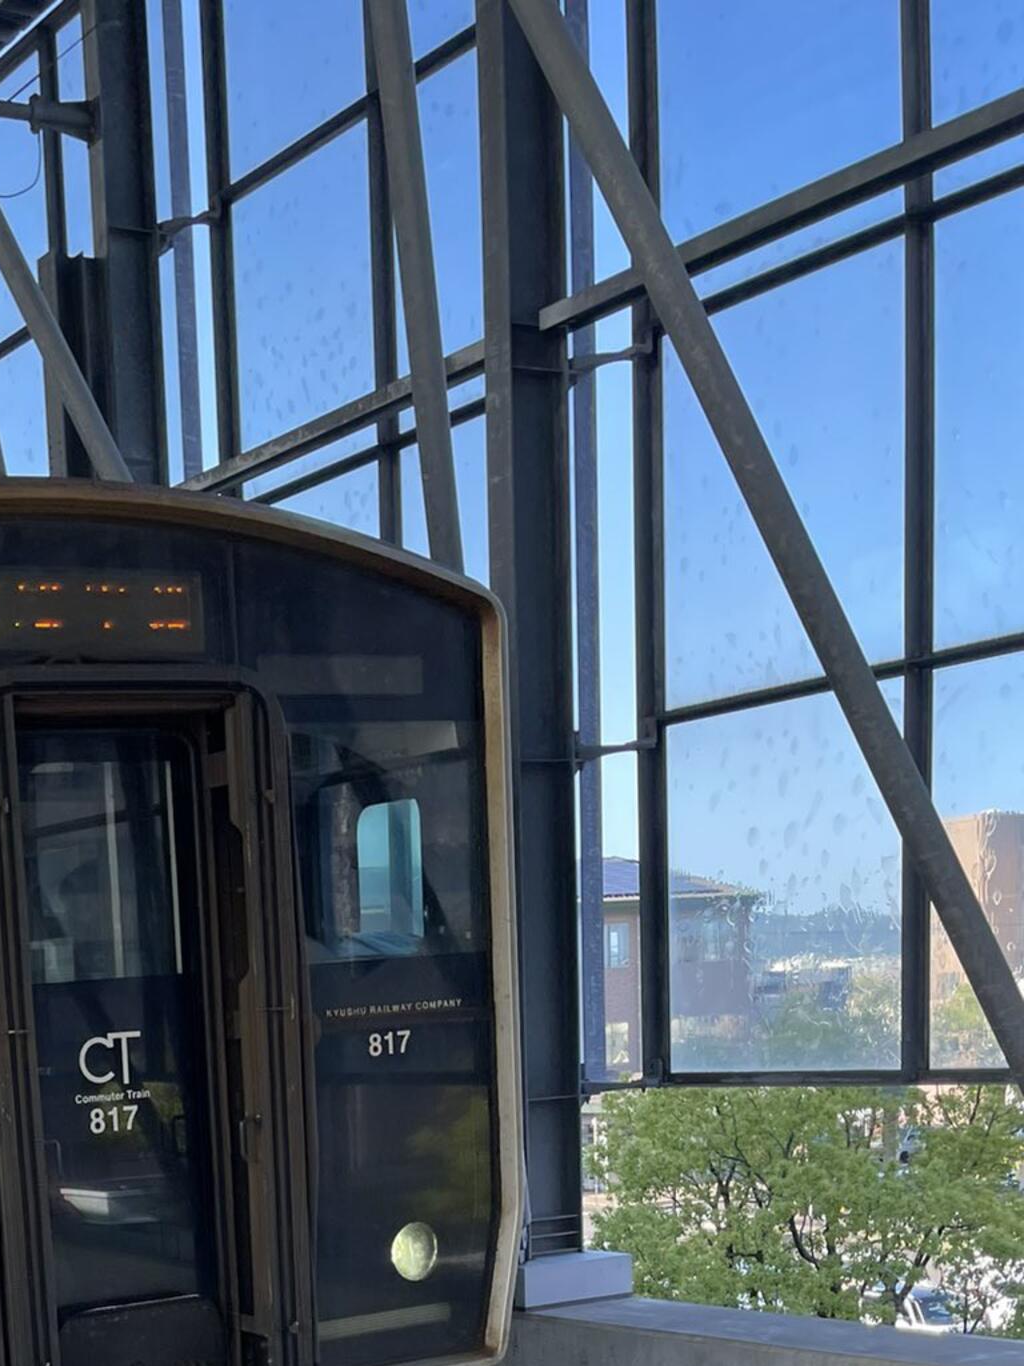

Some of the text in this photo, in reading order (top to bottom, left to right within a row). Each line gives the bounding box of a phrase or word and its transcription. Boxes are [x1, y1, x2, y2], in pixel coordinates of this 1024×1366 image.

[326, 998, 463, 1018] KYUSHU RAILWAY COMPANY
[368, 1029, 411, 1057] 817
[79, 1030, 141, 1085] CT
[74, 1089, 152, 1105] Commuter Train
[89, 1104, 139, 1135] 817
